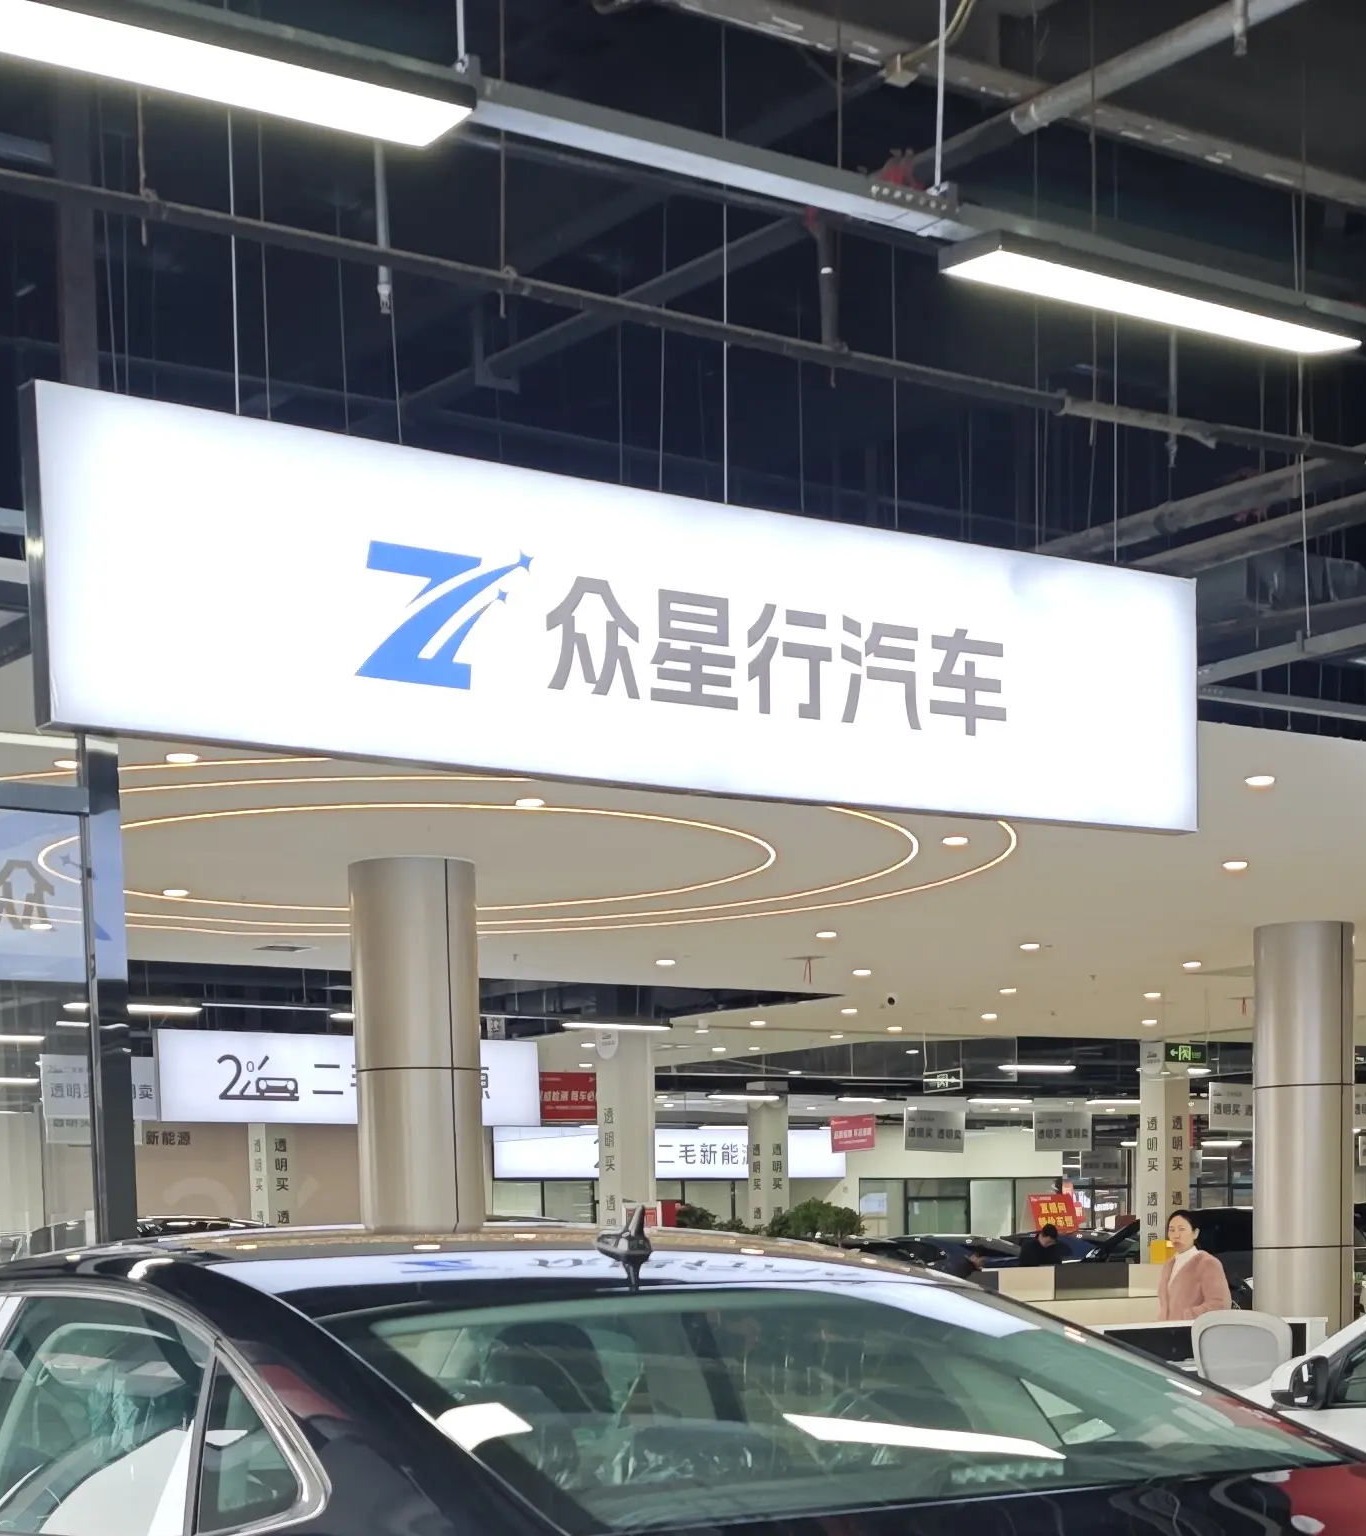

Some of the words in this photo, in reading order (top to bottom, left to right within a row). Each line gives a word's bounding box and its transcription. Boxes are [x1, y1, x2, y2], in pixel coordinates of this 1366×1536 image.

[546, 576, 1007, 736] 众星行汽车
[146, 1131, 191, 1146] 新能源
[274, 1137, 289, 1192] 透明买
[1147, 1116, 1158, 1172] 透明买
[1172, 1115, 1183, 1171] 透明买
